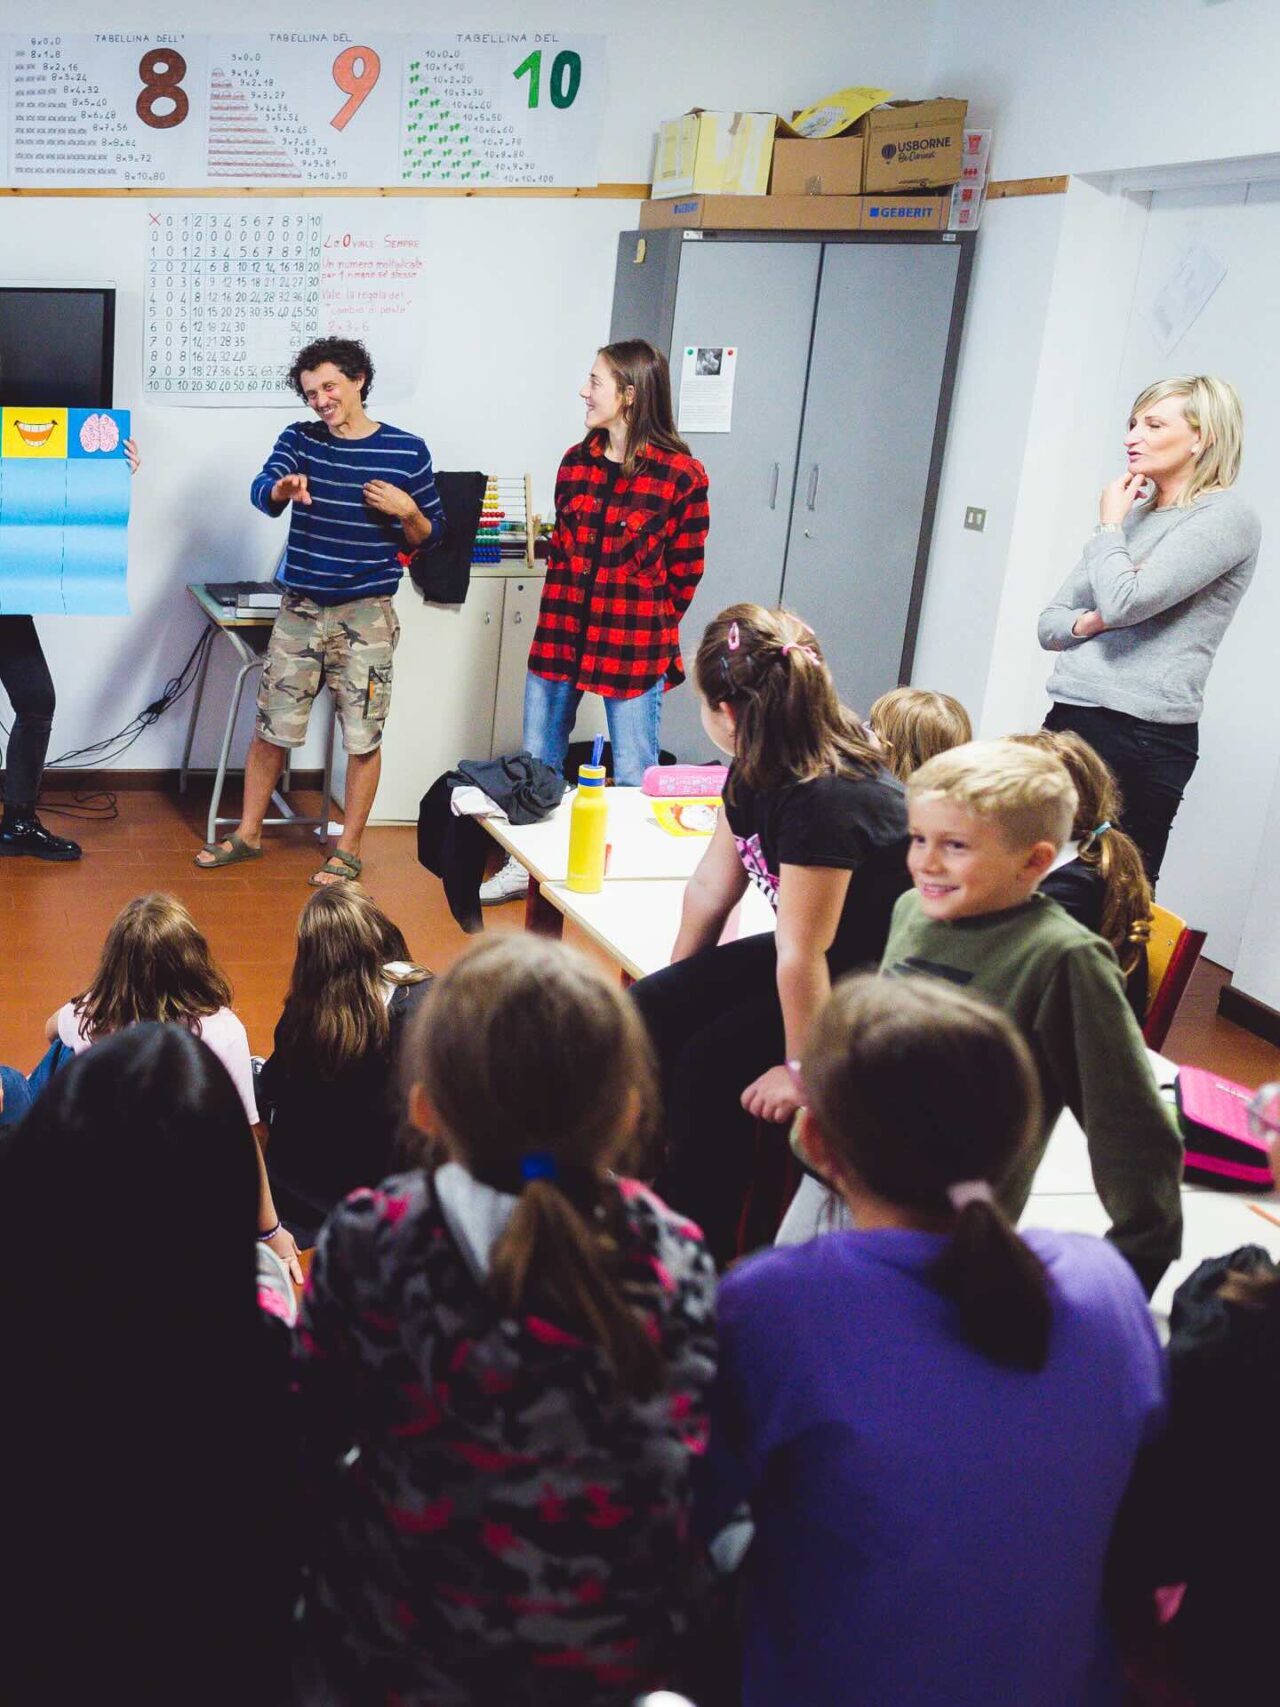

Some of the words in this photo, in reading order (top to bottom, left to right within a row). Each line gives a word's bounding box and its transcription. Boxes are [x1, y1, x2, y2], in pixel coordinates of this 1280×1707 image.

[95, 34, 149, 43] TABELLINA
[270, 33, 328, 42] TABELLINA
[333, 34, 352, 42] DEL
[456, 34, 527, 43] TABELLINA
[535, 34, 559, 43] DEL
[513, 50, 581, 109] 10
[136, 47, 189, 129] 8
[330, 45, 381, 132] 9
[898, 137, 951, 152] USBORNE
[881, 208, 932, 217] GEBERIT
[167, 216, 172, 227] 0
[183, 216, 188, 227] 1
[195, 216, 201, 227] 2
[210, 216, 217, 227] 3
[224, 216, 231, 227] 4
[240, 217, 247, 226] 5
[254, 216, 260, 226] 6
[267, 217, 273, 226] 7
[282, 216, 289, 226] 8
[297, 216, 303, 226] 9
[311, 217, 320, 226] 10
[151, 262, 157, 272] 2
[166, 262, 173, 272] 0
[181, 262, 187, 272] 2
[194, 262, 200, 274] 4
[210, 262, 216, 272] 6
[223, 262, 229, 272] 8
[237, 262, 247, 272] 10
[252, 262, 260, 272] 12
[265, 262, 275, 273] 14
[280, 262, 289, 272] 16
[293, 262, 304, 271] 18
[308, 262, 318, 272] 20
[150, 307, 156, 317] 5
[166, 307, 172, 317] 0
[180, 308, 186, 317] 5
[193, 307, 203, 317] 10
[208, 307, 217, 317] 15
[221, 308, 232, 317] 20
[235, 308, 246, 317] 25
[249, 308, 261, 317] 30
[264, 307, 274, 317] 35
[278, 308, 288, 318] 40
[292, 307, 303, 317] 45
[306, 307, 317, 317] 50
[147, 381, 159, 390] 10
[165, 380, 171, 390] 0
[178, 381, 188, 390] 10
[192, 381, 202, 390] 20
[206, 381, 216, 391] 30
[219, 381, 230, 392] 40
[233, 381, 244, 391] 50
[248, 380, 258, 390] 60
[261, 380, 271, 390] 70
[275, 380, 286, 390] 80
